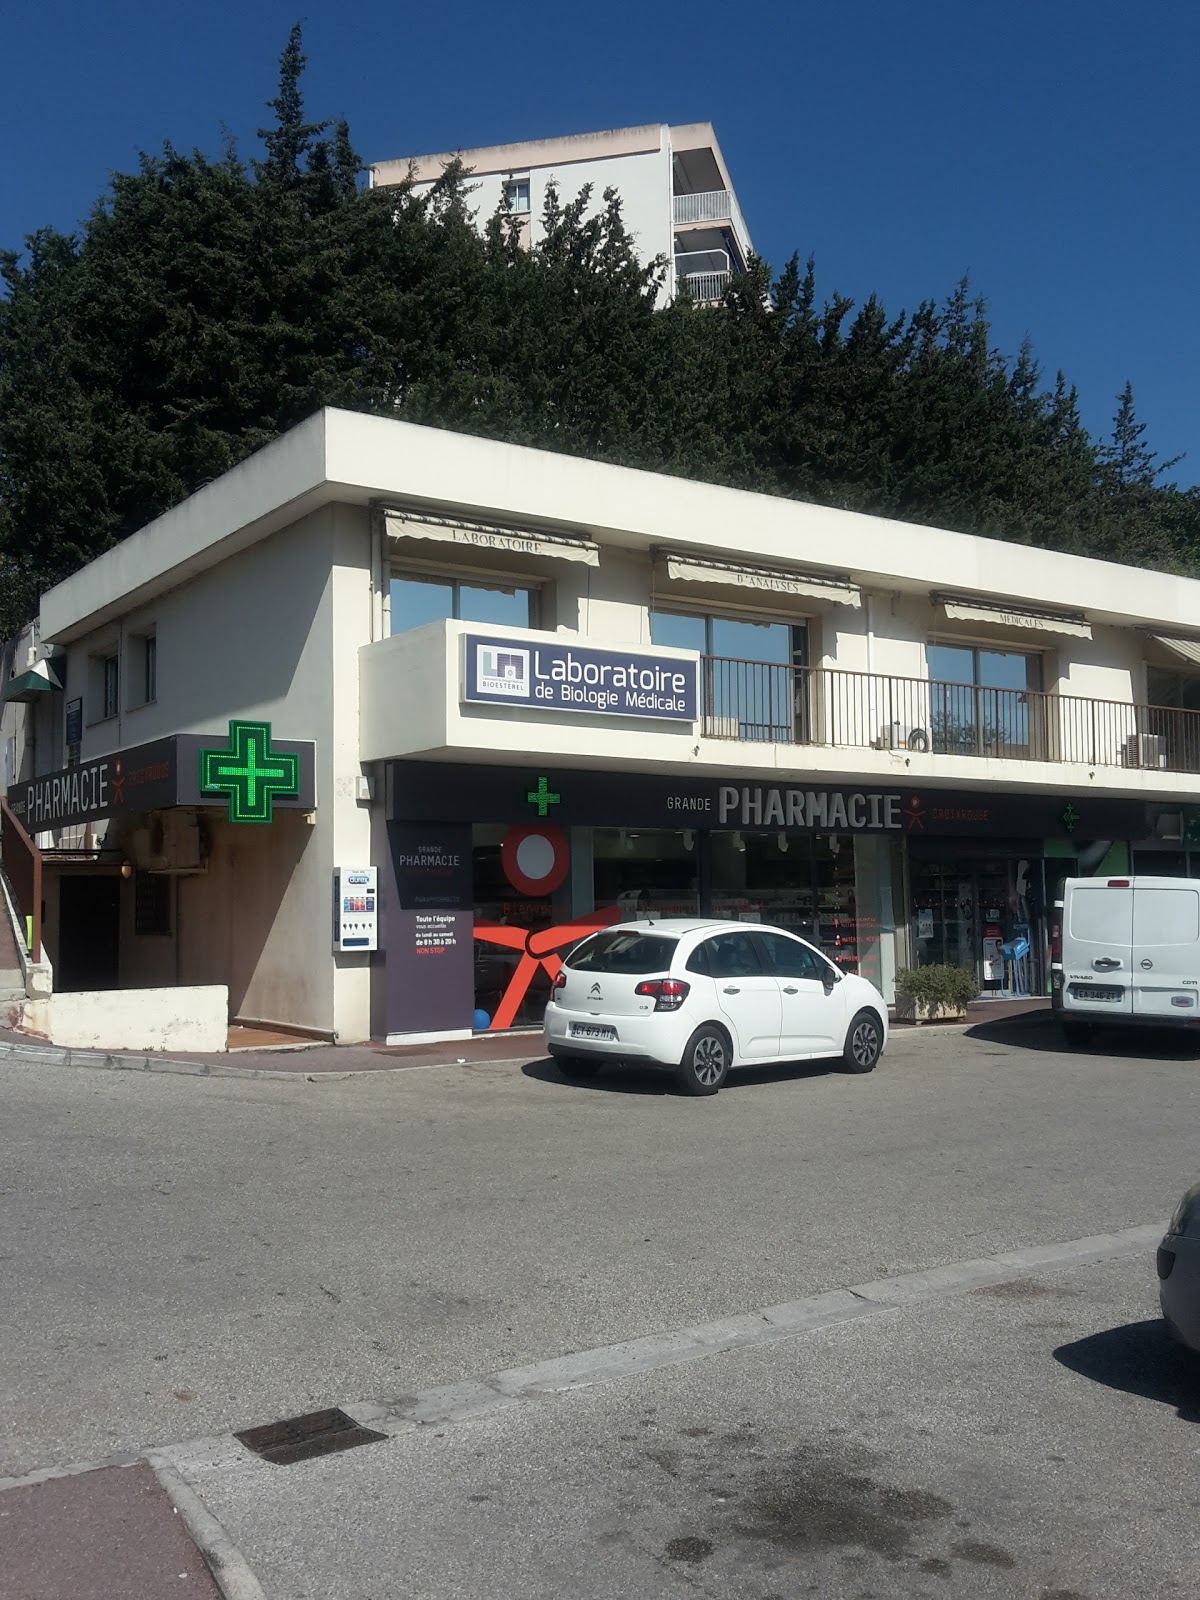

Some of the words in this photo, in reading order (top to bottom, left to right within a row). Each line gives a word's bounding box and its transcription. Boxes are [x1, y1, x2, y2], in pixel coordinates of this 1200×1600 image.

[452, 529, 542, 555] LABORATOIRE
[737, 574, 799, 592] D'ANALYSES
[534, 650, 686, 693] Laboratoire
[482, 681, 524, 691] BIOESTEREL
[535, 682, 554, 699] de
[561, 685, 619, 709] Biologie
[625, 691, 686, 712] Médicale
[27, 764, 109, 824] PHARMACIE
[666, 796, 712, 811] GRANDE
[718, 786, 903, 829] PHARMACIE
[399, 855, 460, 866] PHARMACIE
[432, 915, 456, 924] l'équipe
